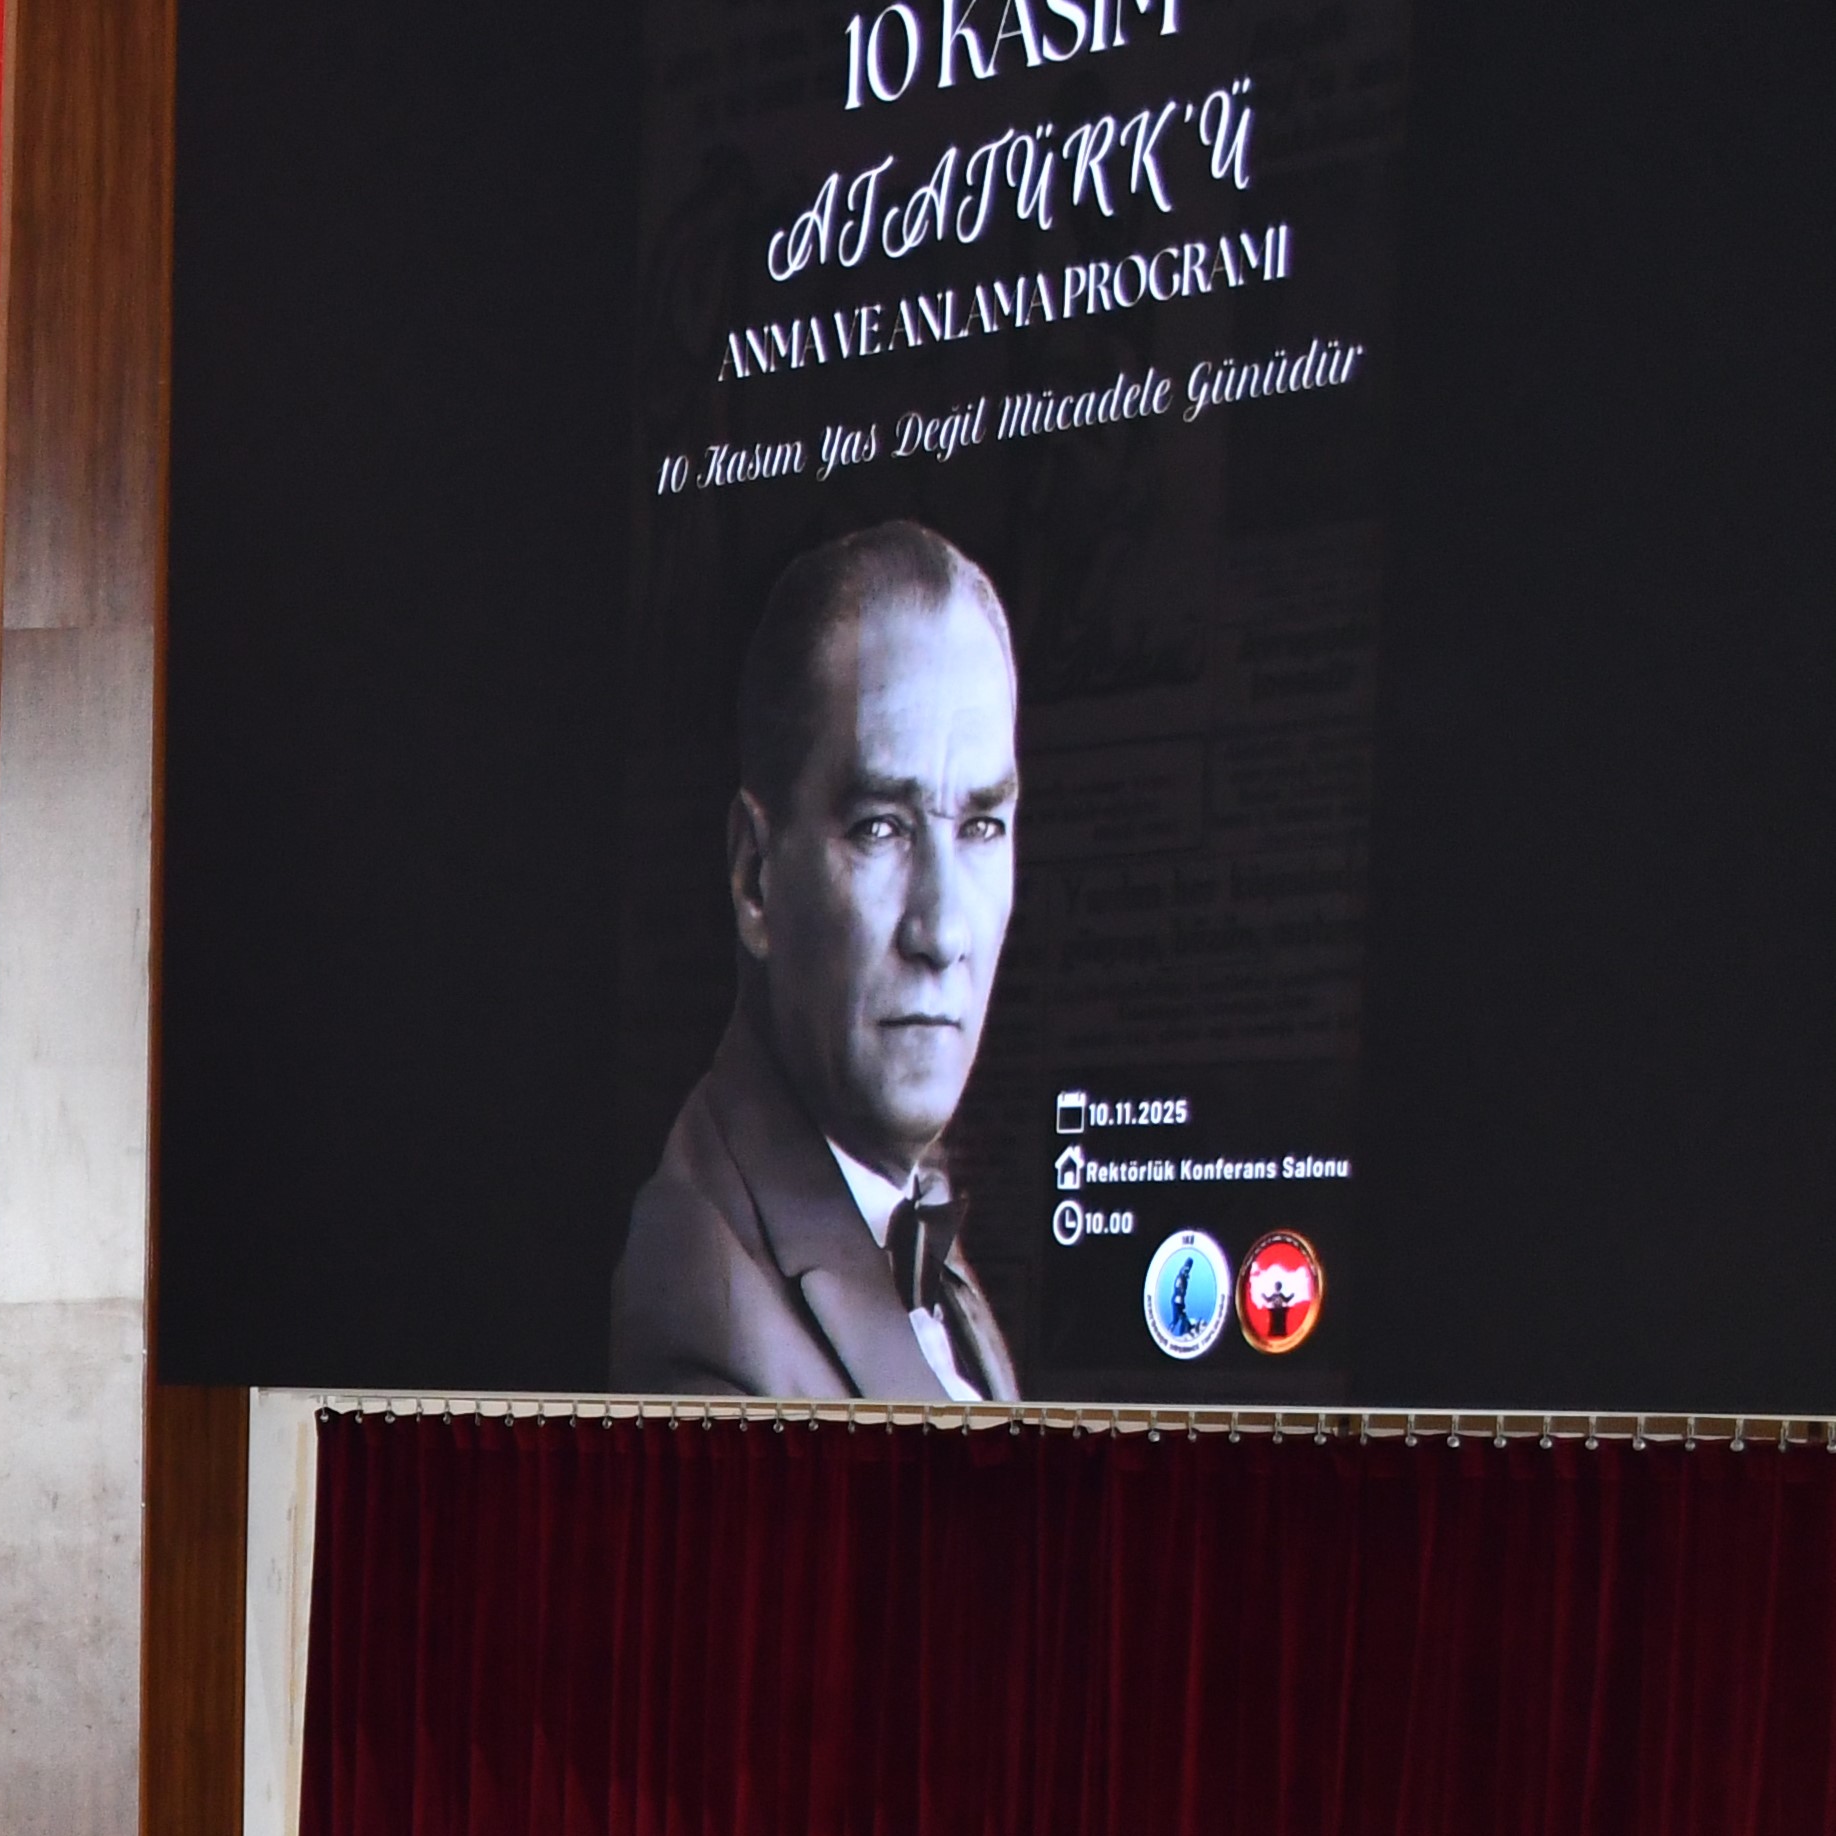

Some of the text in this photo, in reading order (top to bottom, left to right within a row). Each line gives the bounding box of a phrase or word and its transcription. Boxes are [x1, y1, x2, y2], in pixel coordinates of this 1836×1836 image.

[844, 3, 919, 109] 10
[768, 77, 1252, 281] ATATÜRK'Ü
[718, 223, 1291, 382] ANMA VE ANLAMA PROGRAMI
[657, 337, 1365, 495] 10 Kasım Yas Değil Mücadele Günüdür
[1088, 1099, 1188, 1126] 10.11.2025
[1085, 1156, 1349, 1183] Rektörlük Konferans Salonu
[1085, 1212, 1134, 1234] 10.00
